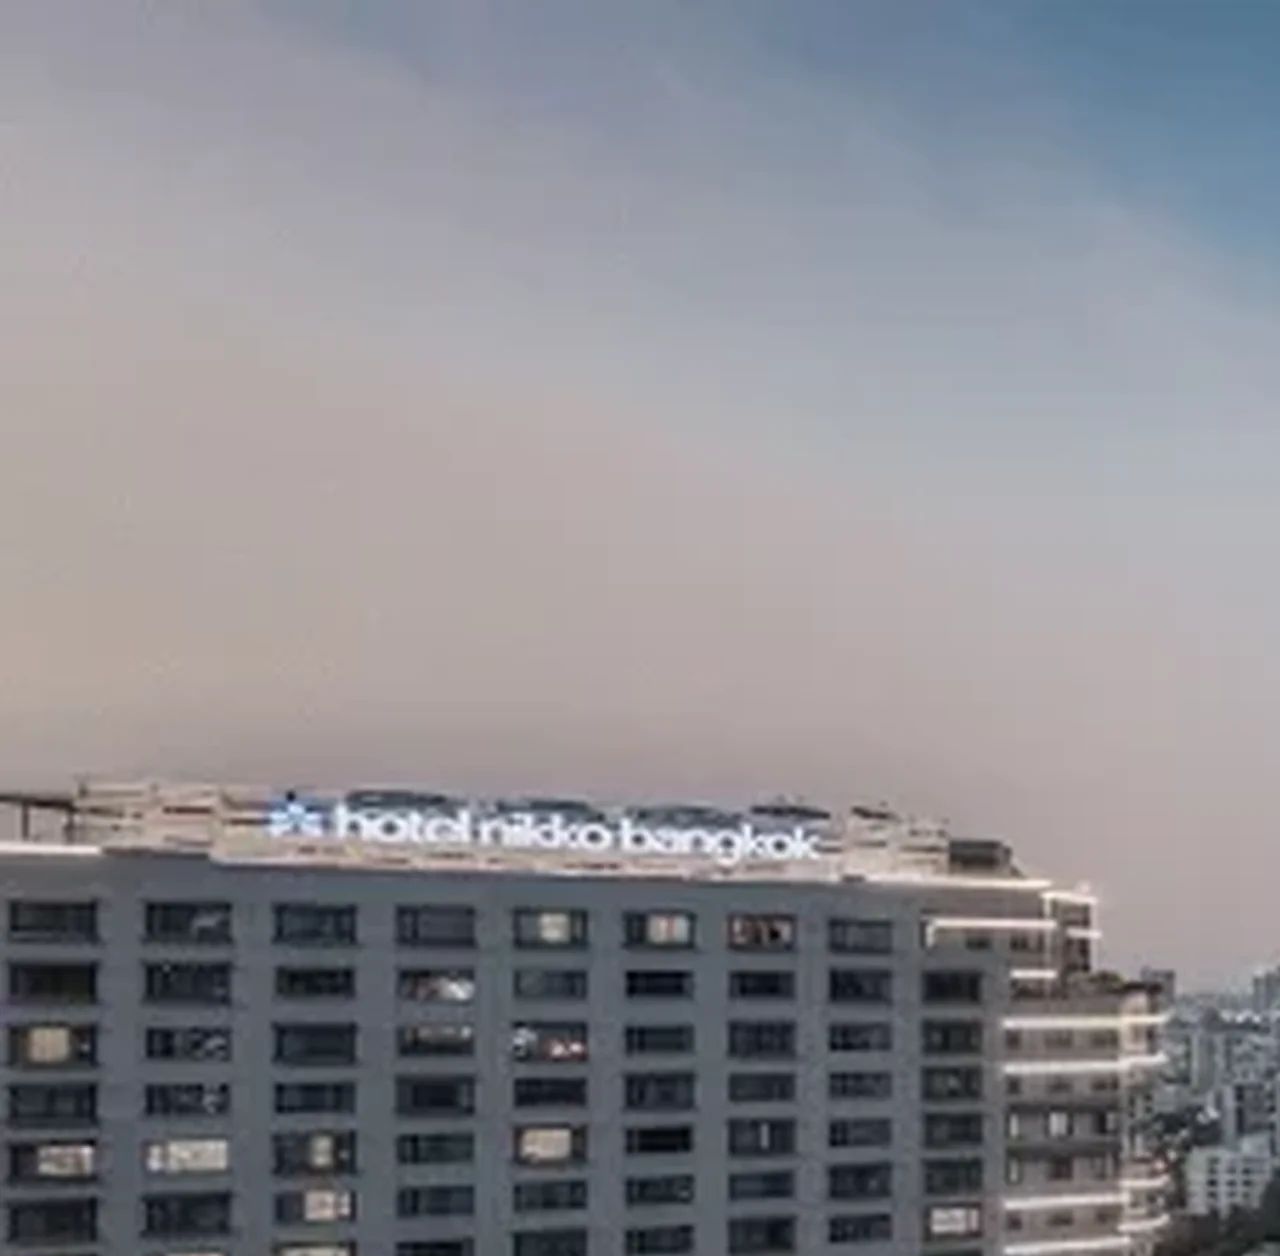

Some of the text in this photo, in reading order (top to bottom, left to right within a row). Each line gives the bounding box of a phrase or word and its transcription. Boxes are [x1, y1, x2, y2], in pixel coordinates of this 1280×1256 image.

[335, 803, 821, 866] hotel nikko bangkok
